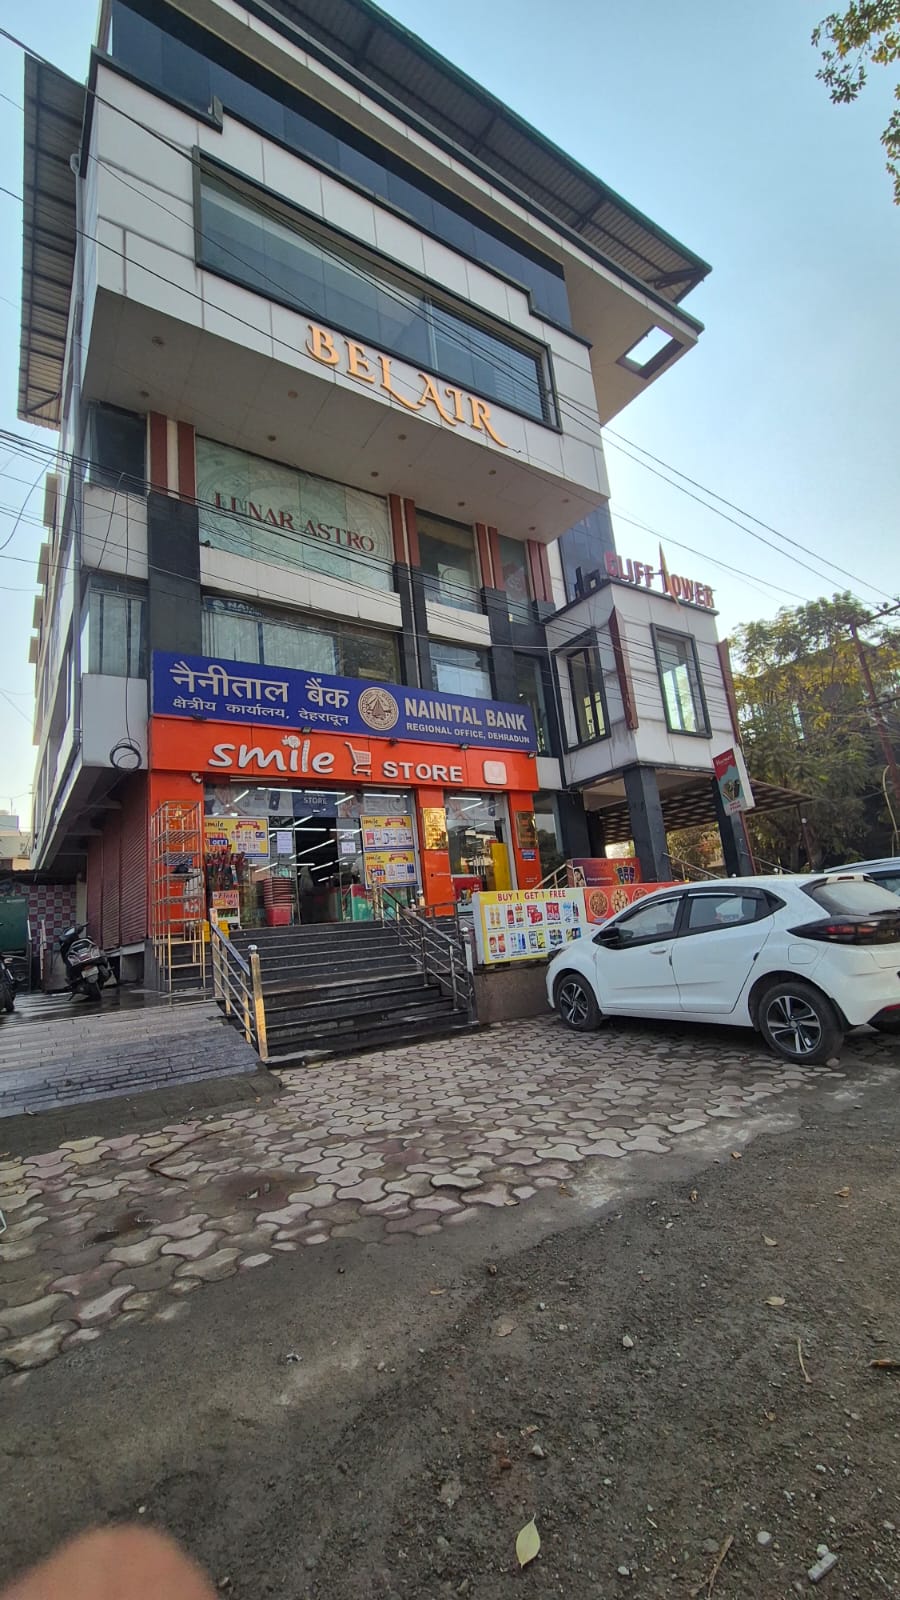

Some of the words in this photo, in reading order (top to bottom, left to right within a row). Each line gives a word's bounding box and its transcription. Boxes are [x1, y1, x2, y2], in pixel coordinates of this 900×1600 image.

[214, 490, 295, 530] LUNAR
[302, 519, 375, 551] ASTRO
[604, 551, 654, 588] CLIFF
[170, 660, 289, 703] नैनीताल
[305, 677, 350, 709] बैंक
[172, 696, 217, 711] क्षेत्रीय
[225, 703, 290, 719] कार्यालय,
[298, 708, 349, 727] देहरादून
[404, 698, 483, 726] NAINITAL
[485, 709, 528, 732] BANK
[406, 722, 452, 735] REGIONAL
[454, 728, 486, 740] OFFICE,
[488, 732, 530, 744] DEHRADUN
[208, 736, 335, 774] smile
[383, 761, 464, 783] STORE
[497, 893, 513, 902] BUY
[516, 892, 519, 901] 1
[524, 891, 540, 900] GET
[549, 890, 566, 899] FREE
